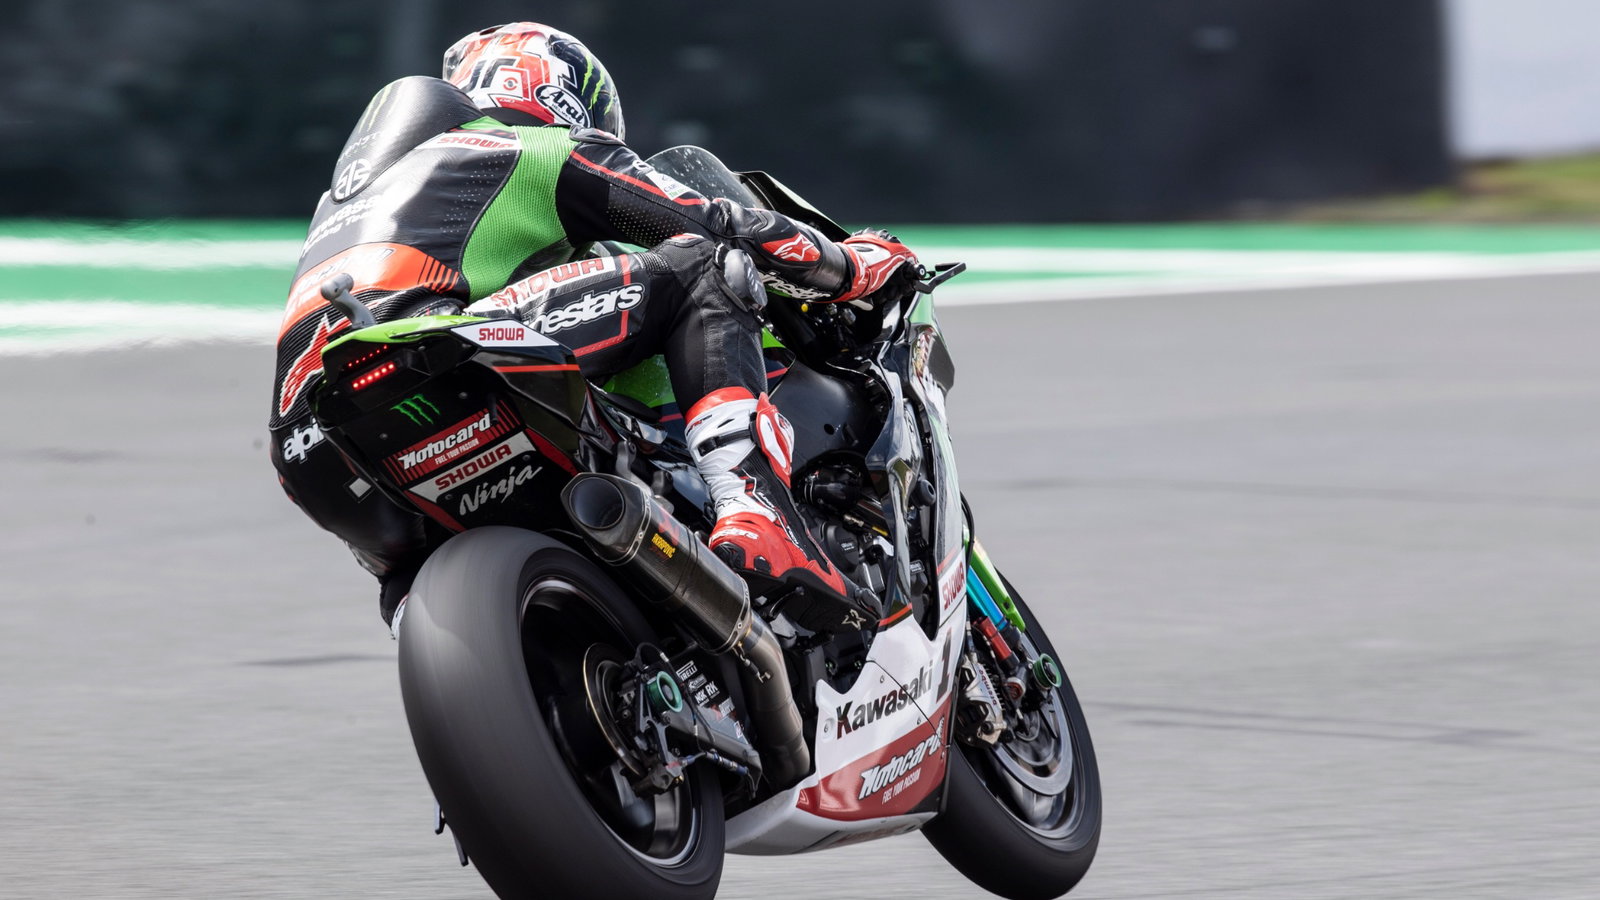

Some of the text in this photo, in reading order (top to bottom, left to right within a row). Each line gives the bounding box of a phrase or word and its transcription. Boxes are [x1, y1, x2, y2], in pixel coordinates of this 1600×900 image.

[540, 91, 585, 124] Arai
[490, 258, 605, 308] SHOWA
[479, 327, 524, 341] SHOWA
[526, 285, 643, 334] nestars
[398, 413, 491, 470] Motocard
[434, 438, 480, 465] FUEL YOUR PASSION
[435, 444, 512, 490] SHOWA
[459, 464, 543, 515] Ninja
[942, 561, 965, 611] SHOWA
[675, 660, 698, 681] PIRELLI
[936, 626, 952, 704] 1
[978, 669, 998, 706] brembo
[694, 689, 708, 704] NGK
[705, 681, 719, 696] RK
[836, 660, 934, 740] Kawasaki
[858, 716, 945, 800] Motocard
